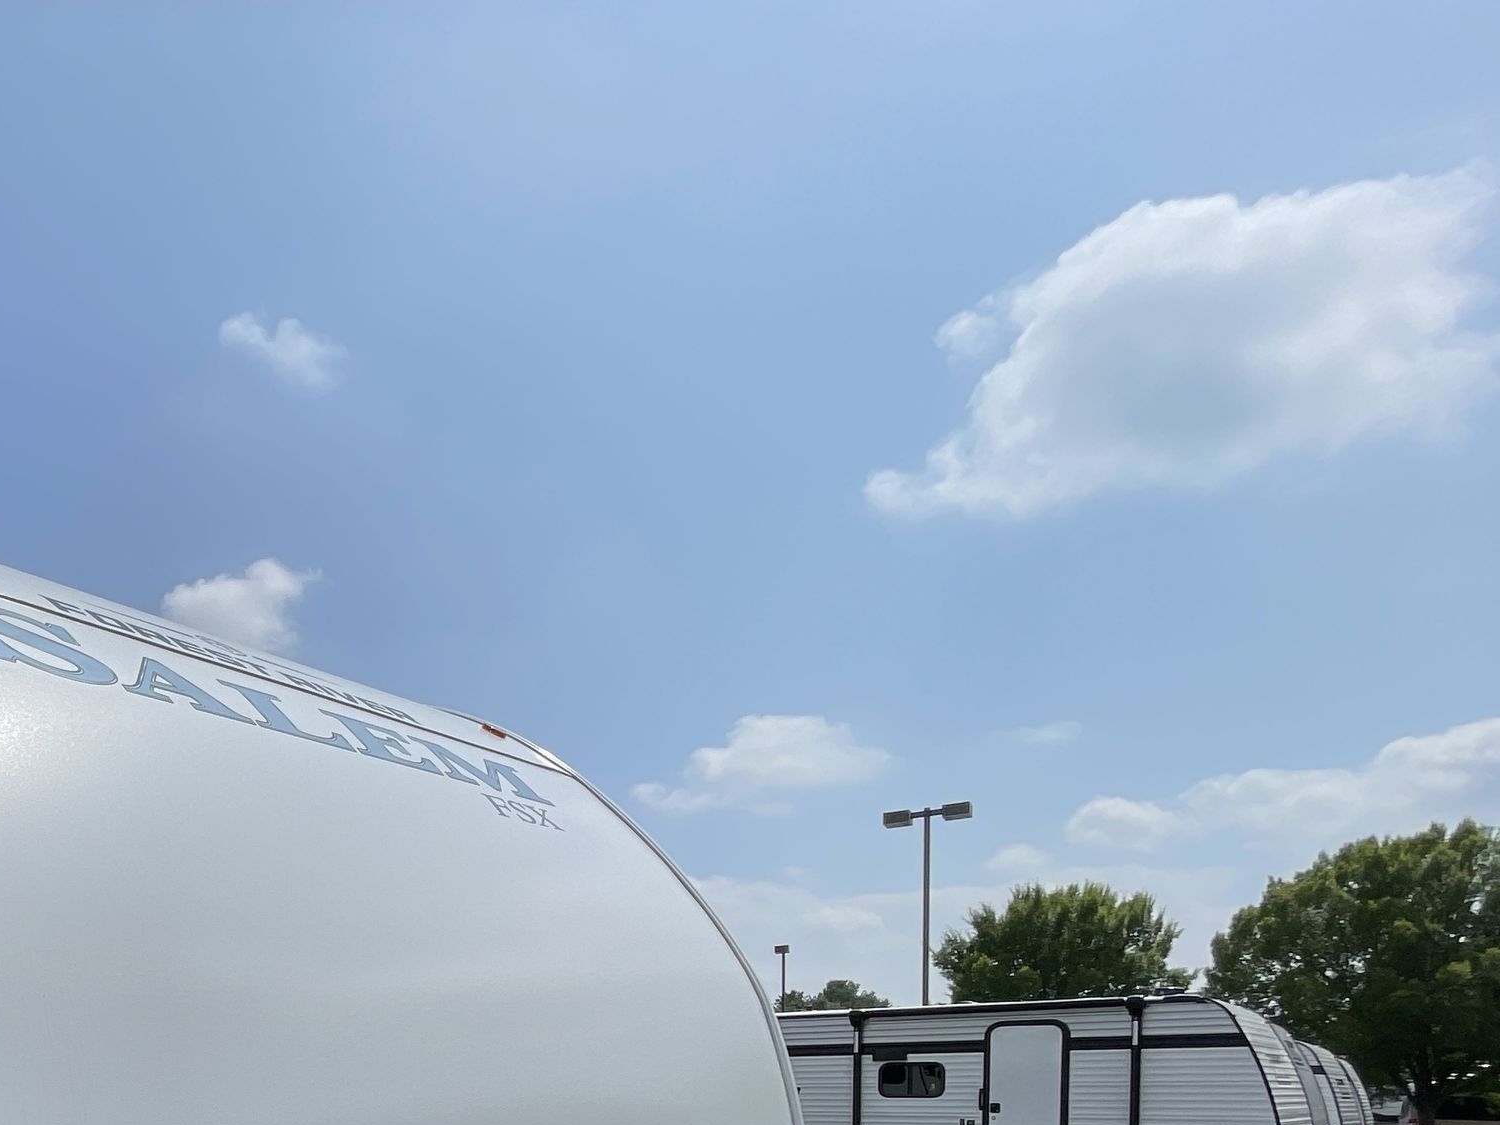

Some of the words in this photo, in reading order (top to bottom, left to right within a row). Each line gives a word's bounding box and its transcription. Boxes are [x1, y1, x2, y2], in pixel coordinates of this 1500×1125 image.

[37, 593, 271, 677] FOREST
[278, 670, 421, 725] RIVER
[480, 792, 566, 832] FSX
